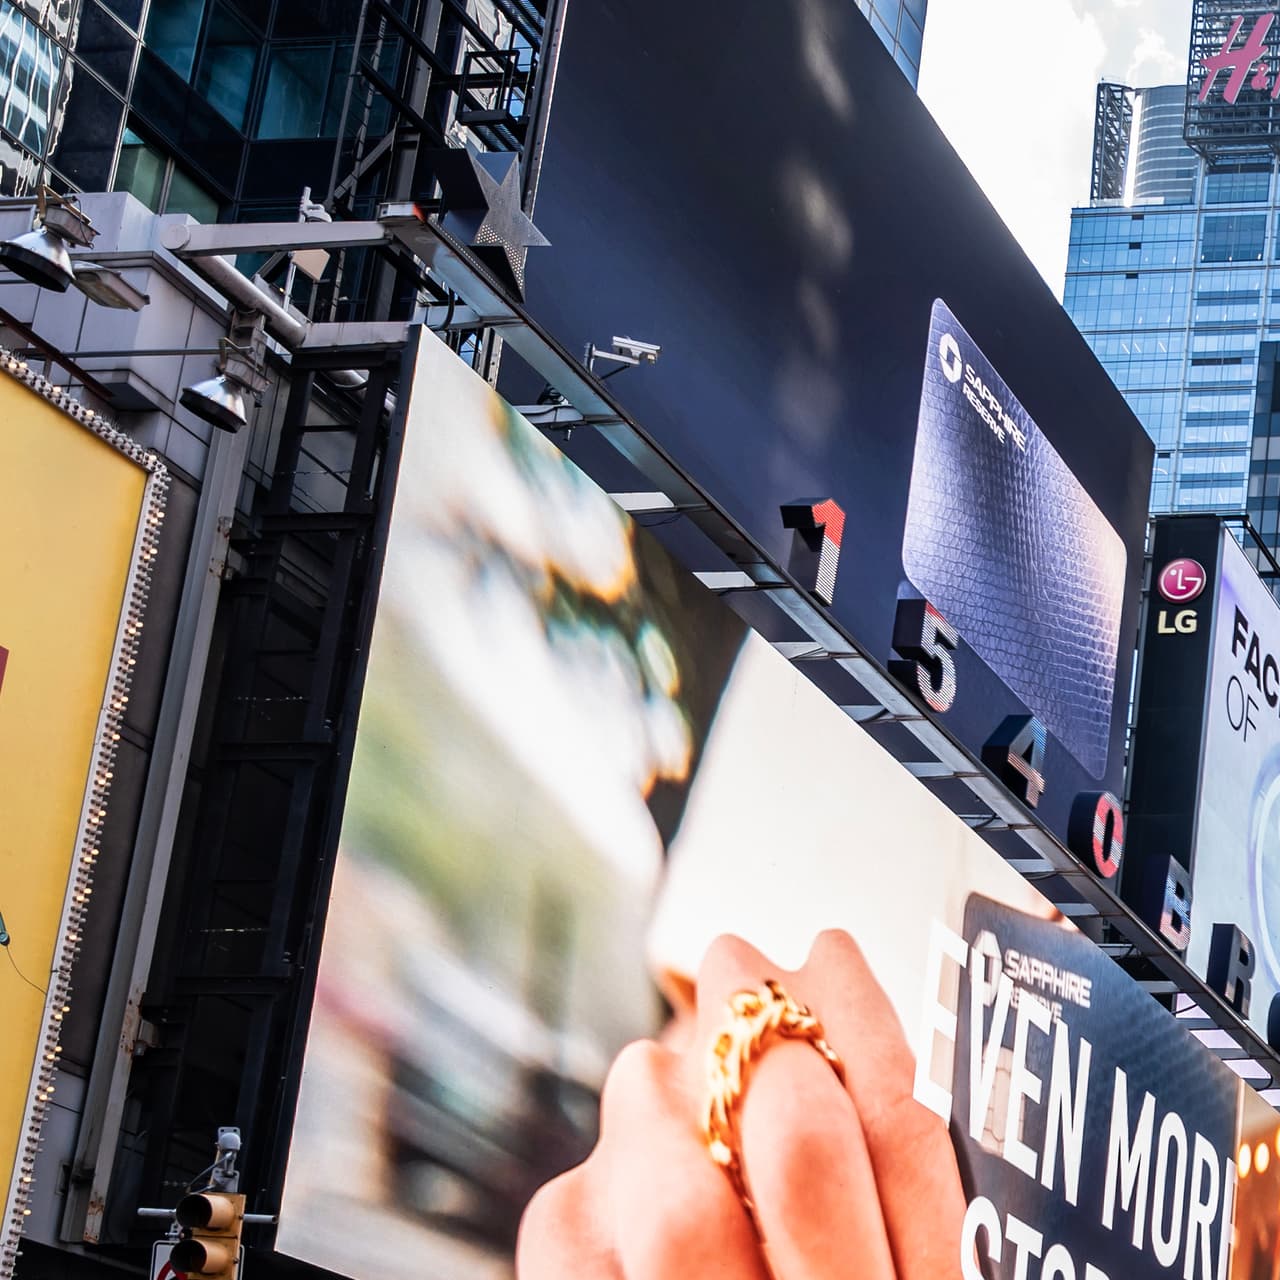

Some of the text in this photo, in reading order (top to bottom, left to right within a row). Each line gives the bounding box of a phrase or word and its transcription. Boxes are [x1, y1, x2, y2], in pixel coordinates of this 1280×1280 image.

[963, 382, 1006, 444] RESERVE
[965, 363, 1026, 452] SAPPHIRE
[1157, 610, 1198, 635] LG
[1226, 678, 1259, 742] OF
[1004, 948, 1092, 1009] SAPPHIRE
[913, 918, 1093, 1208] EVEN
